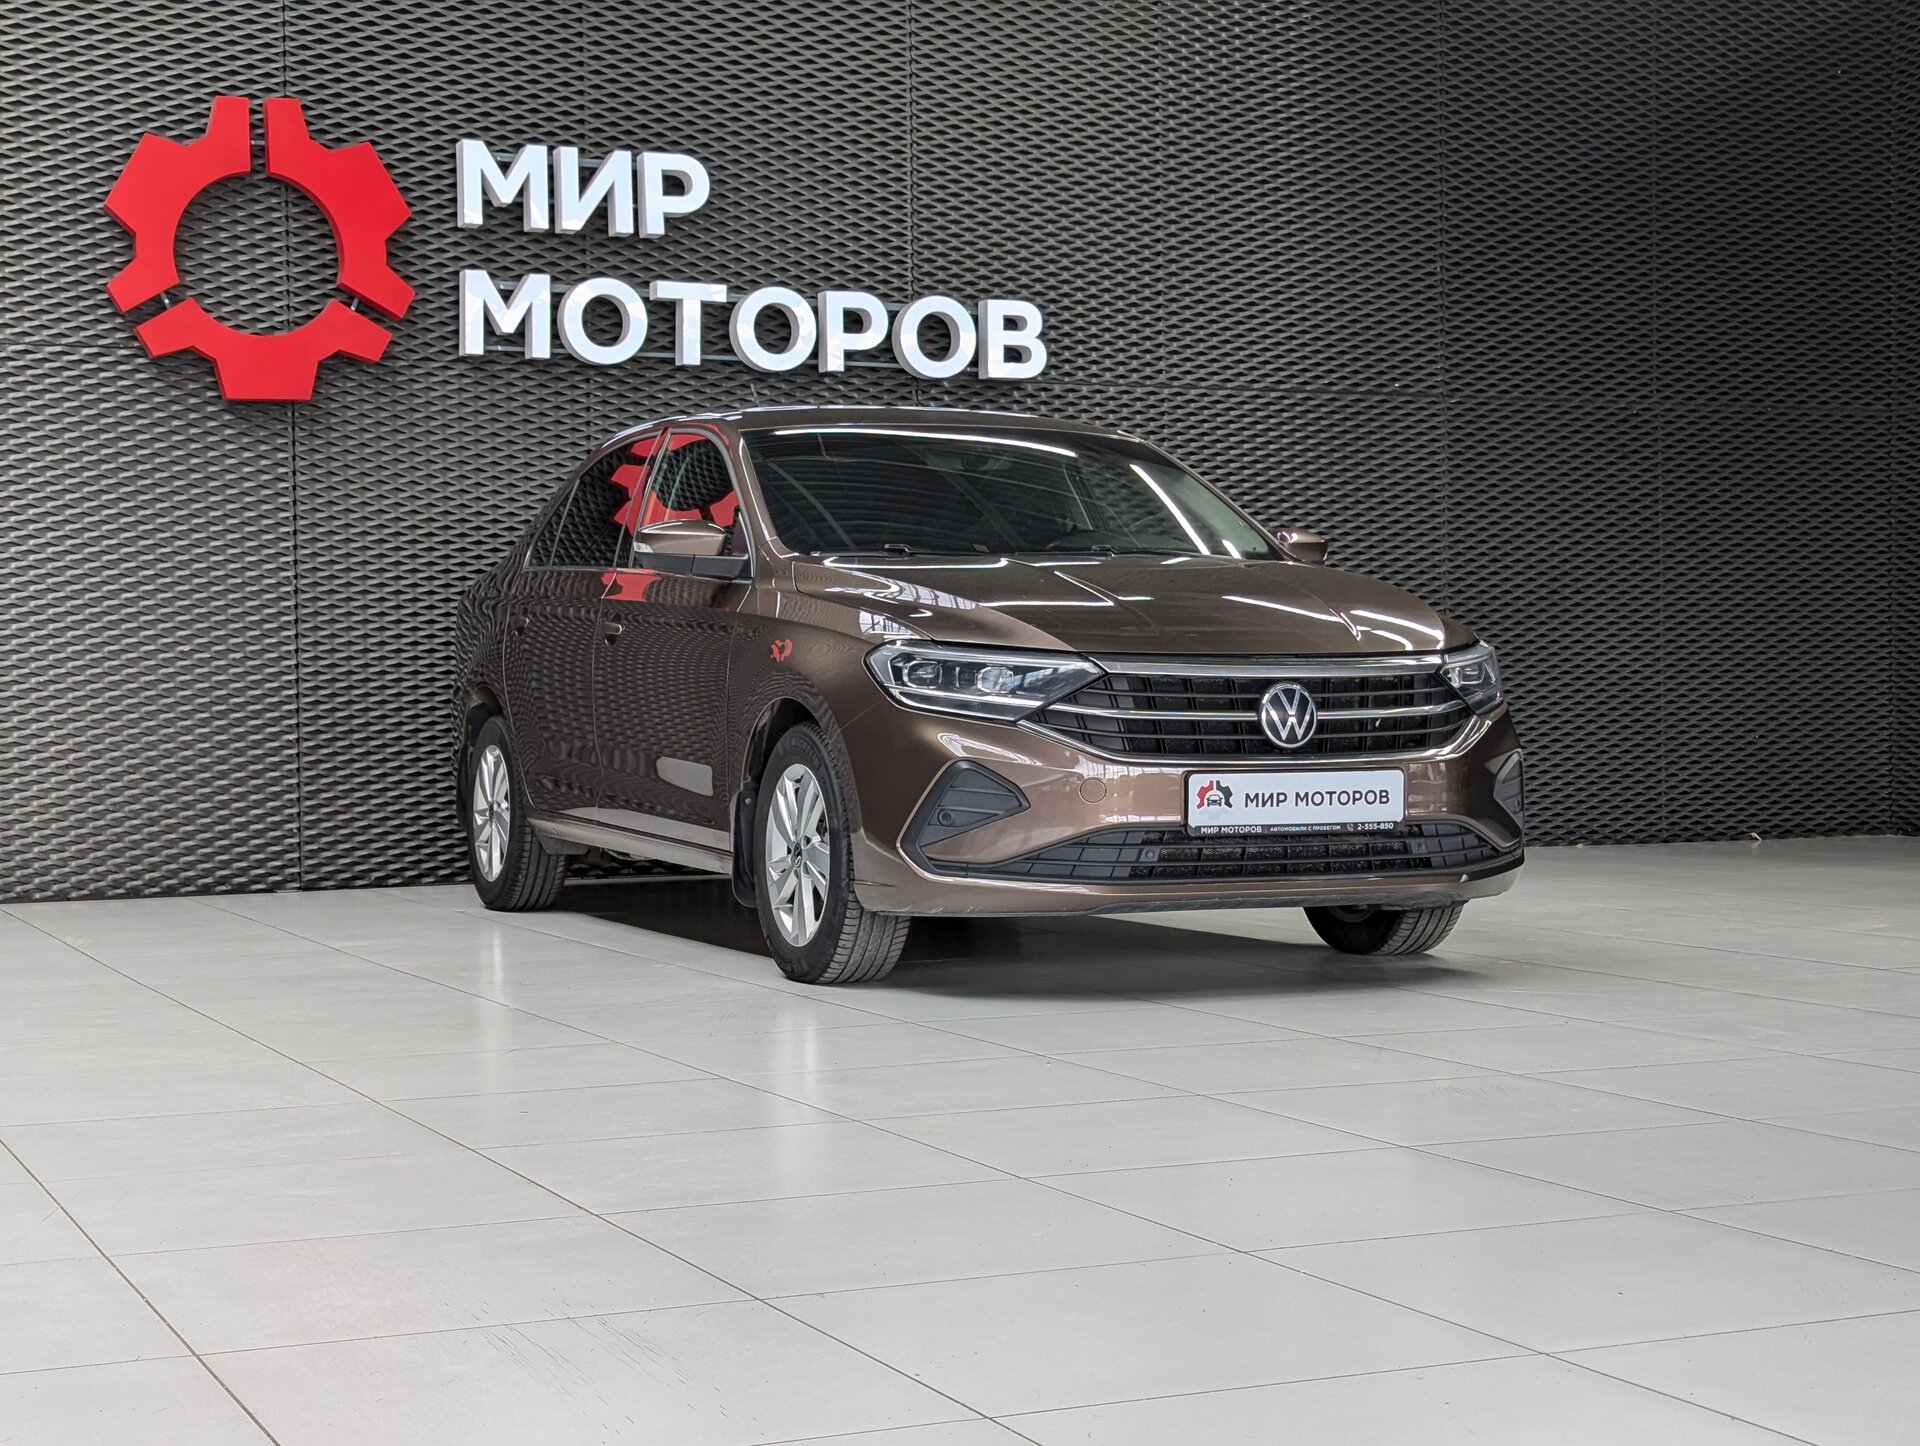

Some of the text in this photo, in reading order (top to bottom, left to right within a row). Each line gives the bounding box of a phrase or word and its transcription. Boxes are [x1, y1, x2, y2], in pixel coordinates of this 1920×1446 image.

[455, 138, 711, 239] МИР
[458, 268, 1049, 381] МОТОРОВ
[1244, 789, 1390, 808] МИР МОТОРОВ
[1200, 826, 1219, 834] МИР
[1357, 822, 1394, 830] 2-555-850
